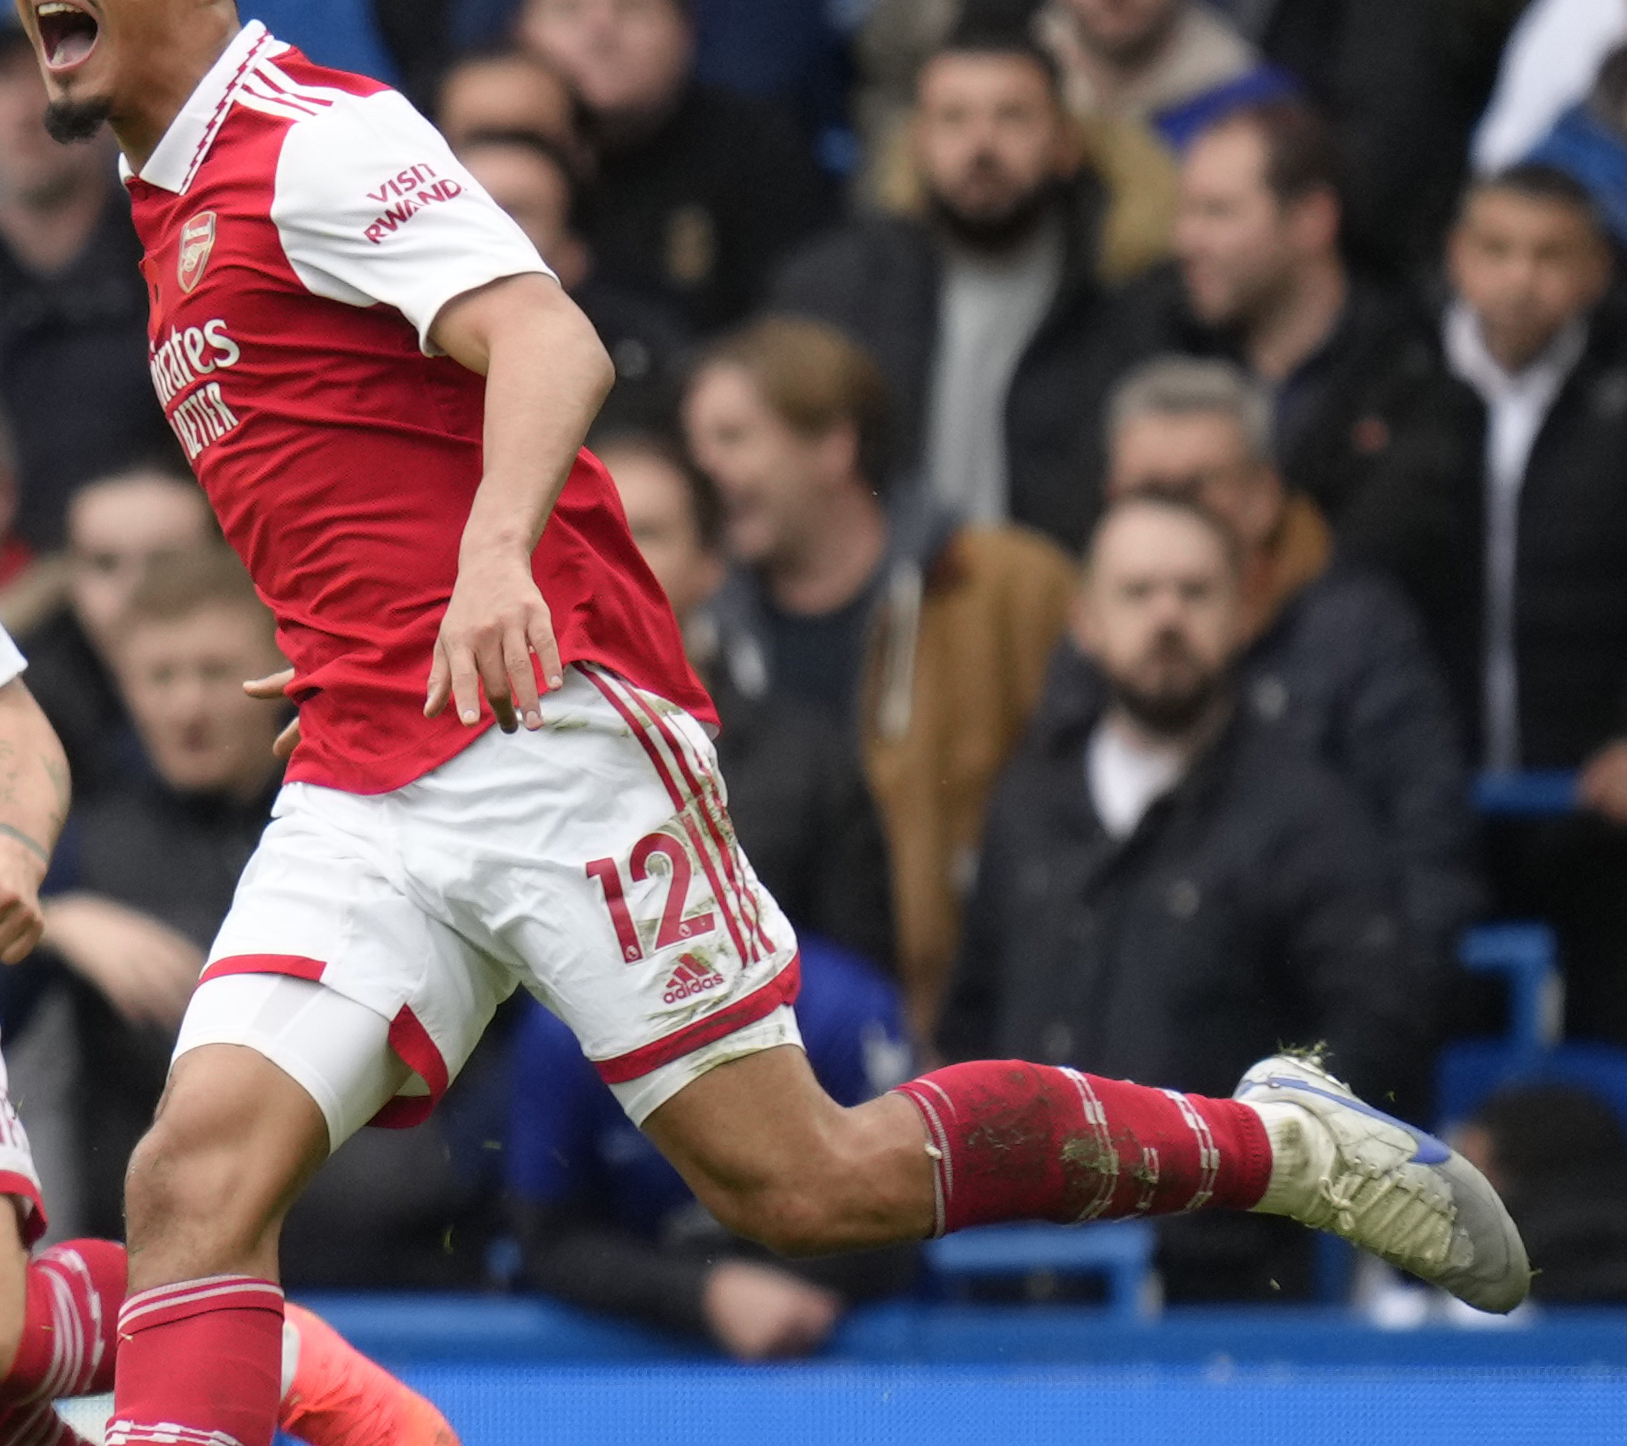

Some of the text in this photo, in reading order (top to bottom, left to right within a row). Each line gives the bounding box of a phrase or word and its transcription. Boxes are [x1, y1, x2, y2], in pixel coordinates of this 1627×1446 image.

[363, 178, 463, 245] RWAND
[365, 162, 437, 204] VISIT
[150, 318, 241, 407] irates
[585, 832, 716, 965] 12
[662, 972, 726, 1005] adidas
